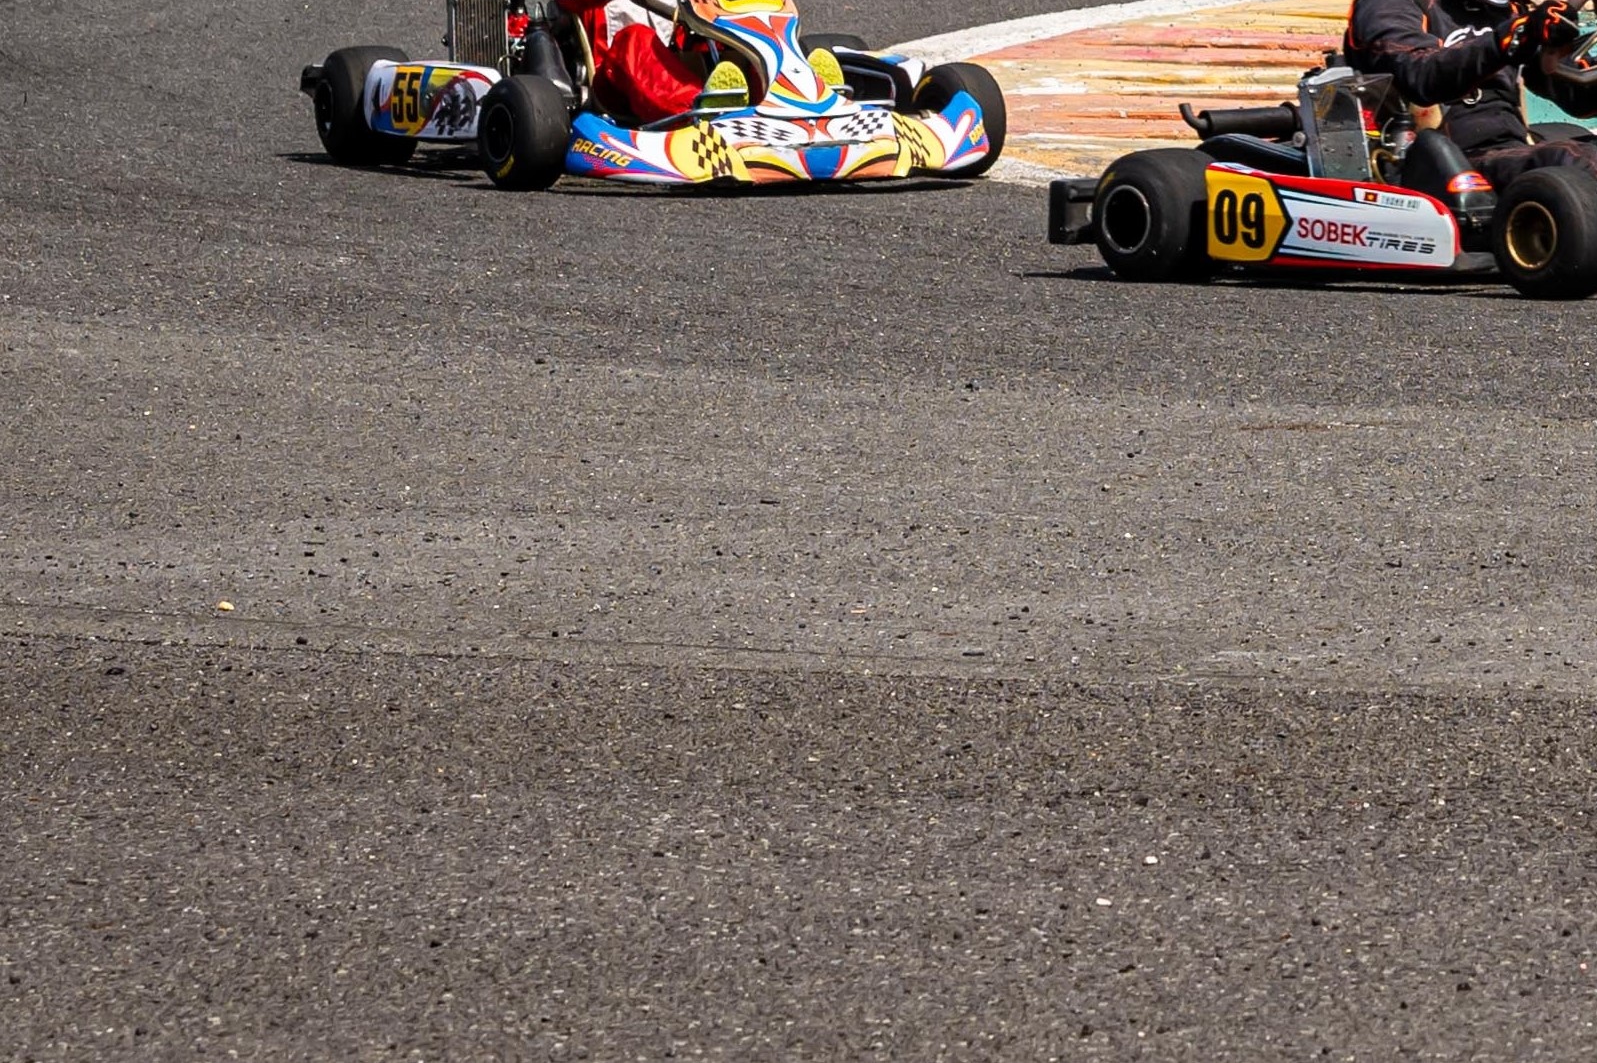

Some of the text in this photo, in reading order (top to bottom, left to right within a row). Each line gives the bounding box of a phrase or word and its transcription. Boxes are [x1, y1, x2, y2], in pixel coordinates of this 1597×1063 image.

[390, 71, 422, 124] 55
[571, 137, 634, 168] RACING
[1213, 189, 1266, 249] 09
[1297, 218, 1368, 247] SOBEK
[1366, 235, 1436, 254] TIRES
